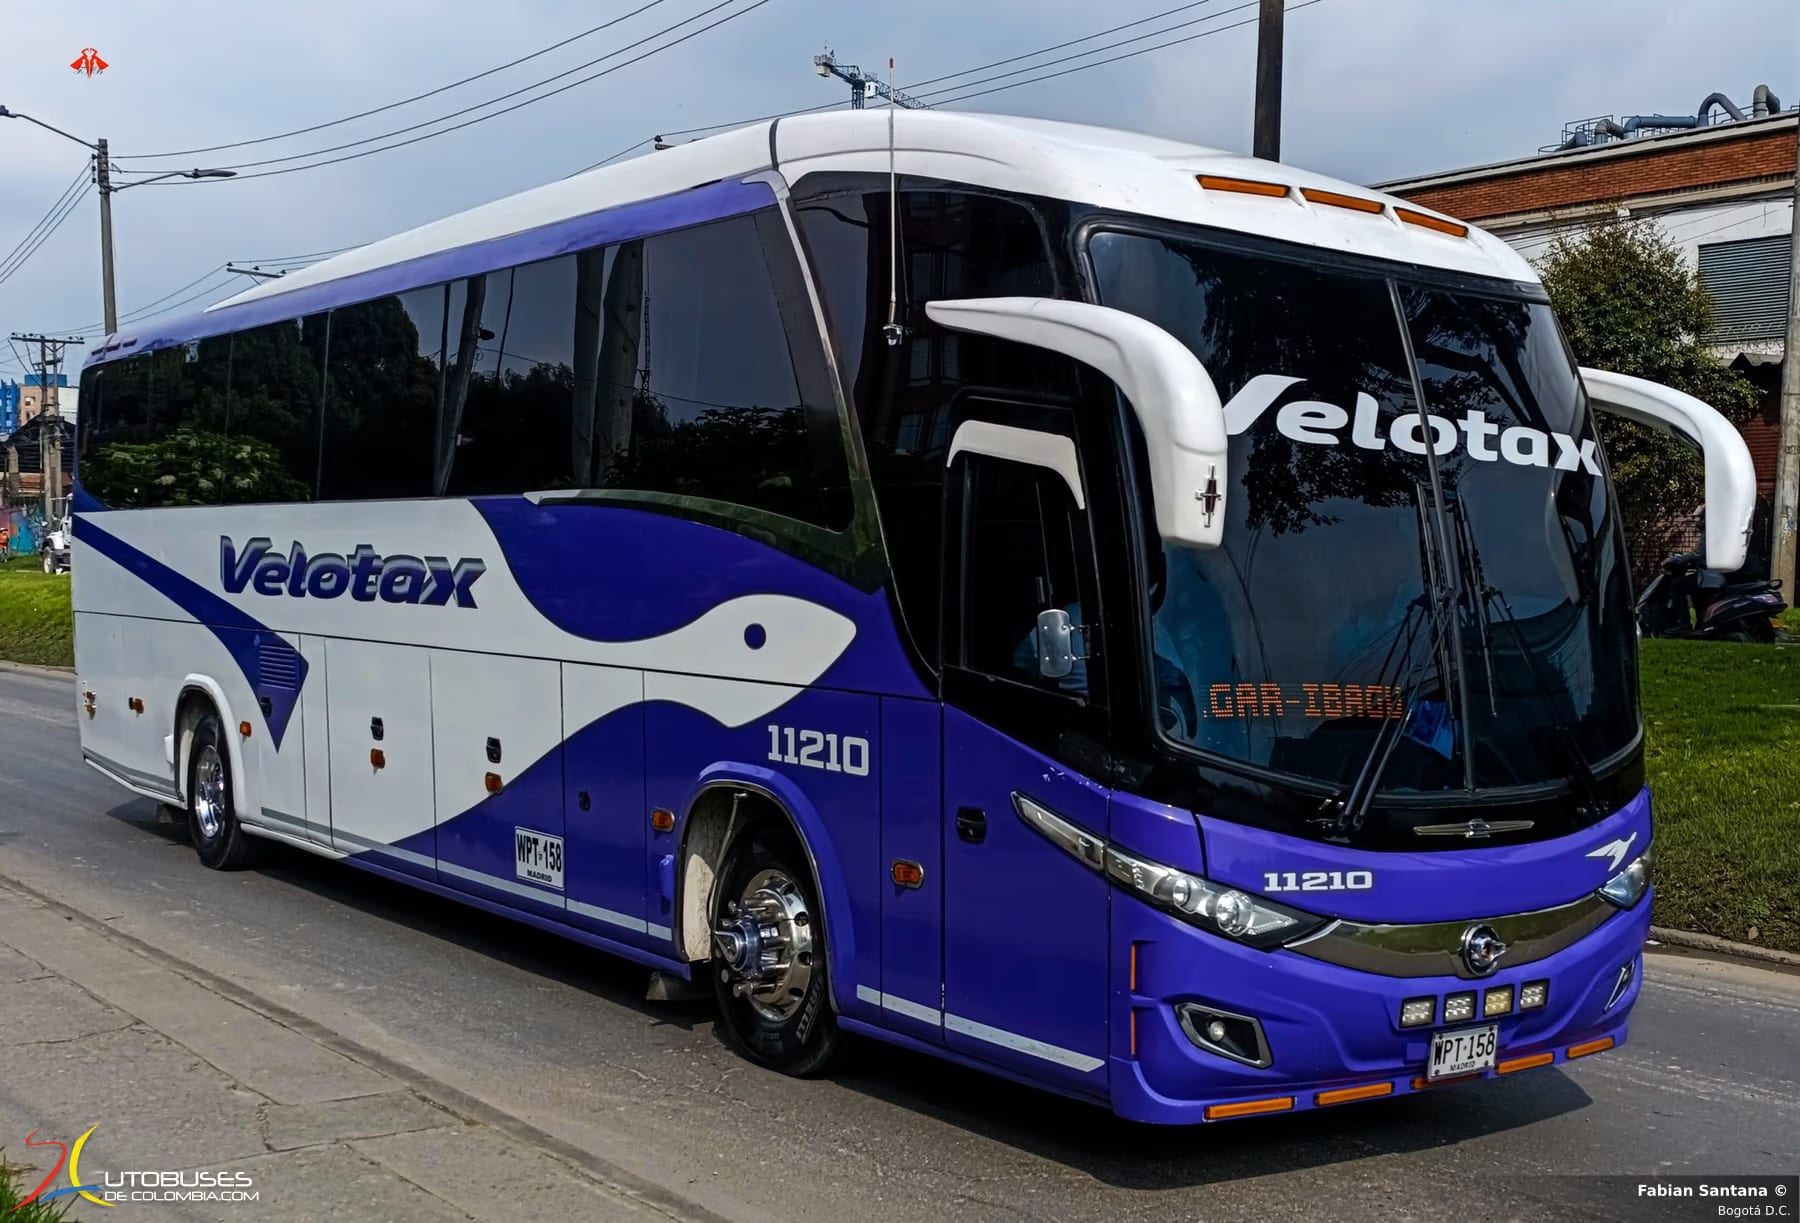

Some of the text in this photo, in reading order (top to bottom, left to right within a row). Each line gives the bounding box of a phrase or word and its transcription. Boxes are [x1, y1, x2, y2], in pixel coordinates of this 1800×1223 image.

[220, 534, 487, 610] Velotax
[768, 725, 869, 776] 11210
[526, 869, 553, 882] MADRID
[1263, 871, 1374, 892] 11210
[1433, 1031, 1495, 1066] WPT 158
[1450, 1060, 1476, 1071] MADRID
